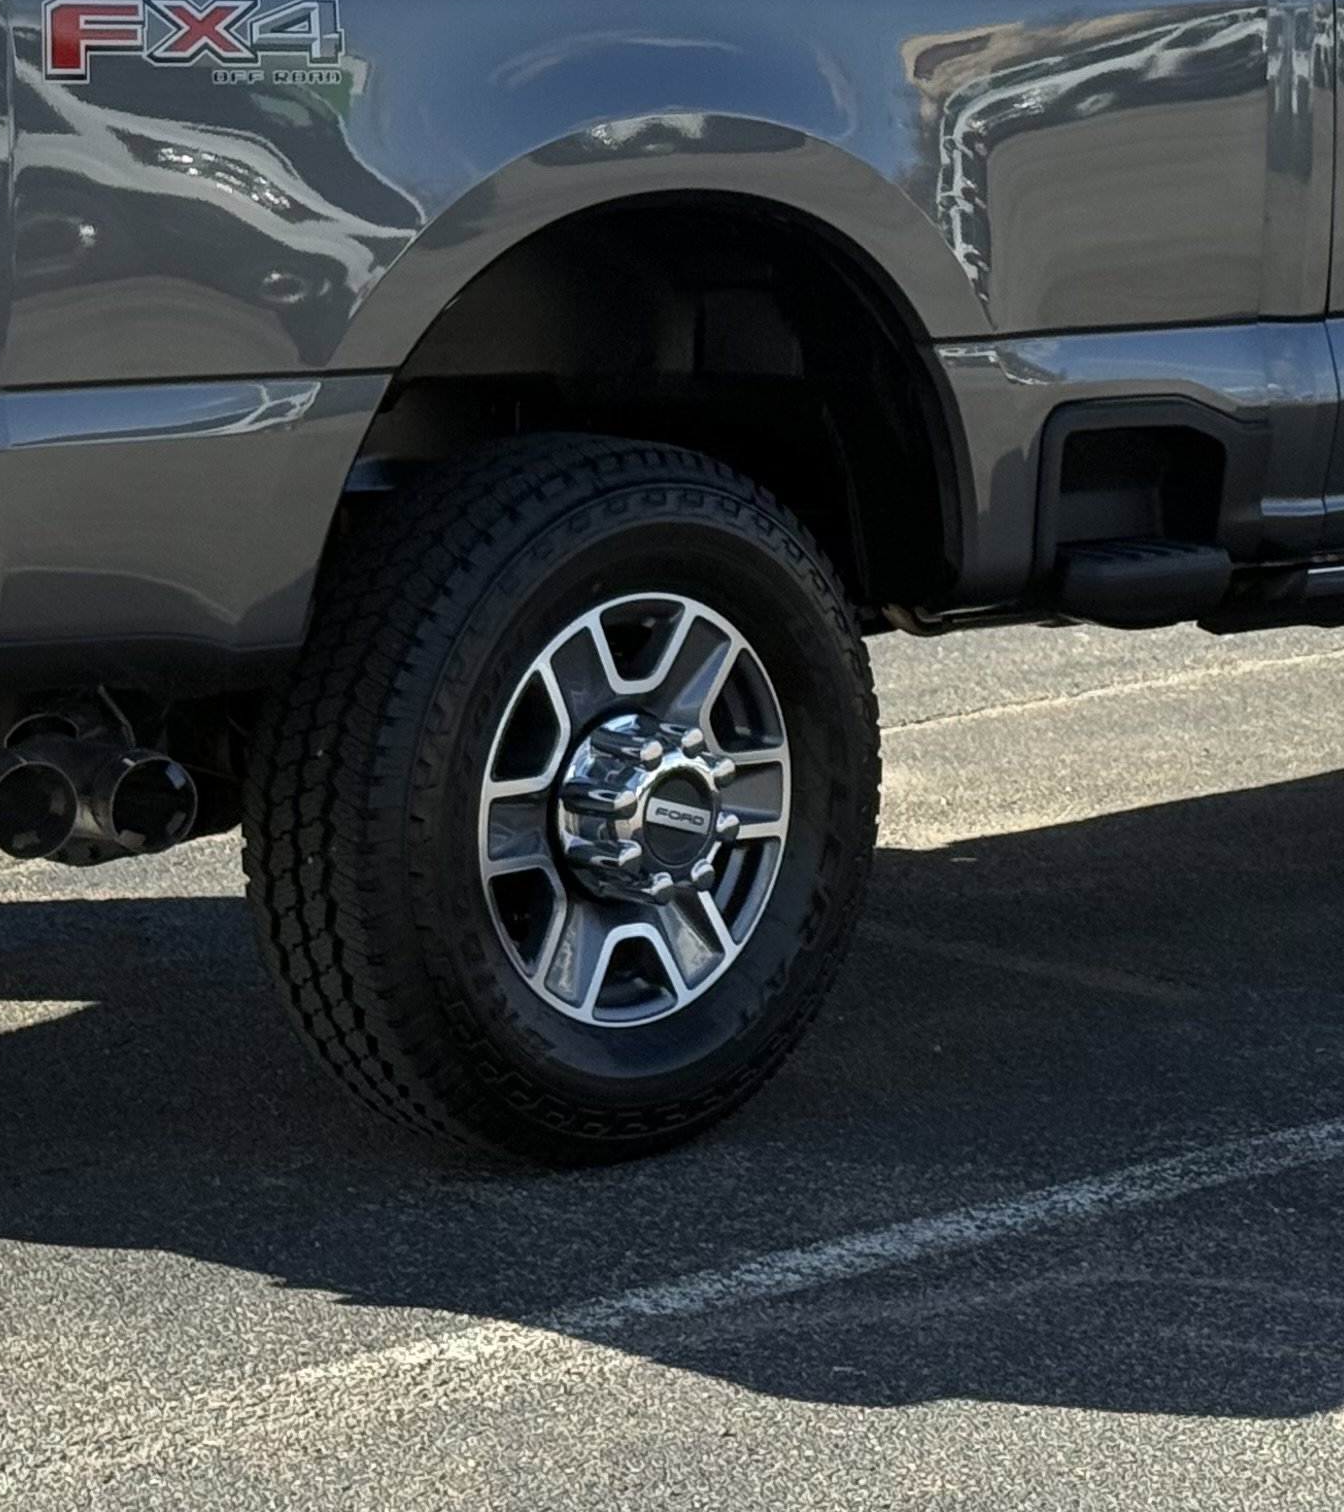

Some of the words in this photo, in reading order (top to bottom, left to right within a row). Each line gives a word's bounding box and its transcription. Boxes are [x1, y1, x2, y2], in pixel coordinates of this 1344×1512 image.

[212, 69, 265, 85] OFF
[273, 69, 342, 85] ROAD
[655, 807, 705, 826] FORD
